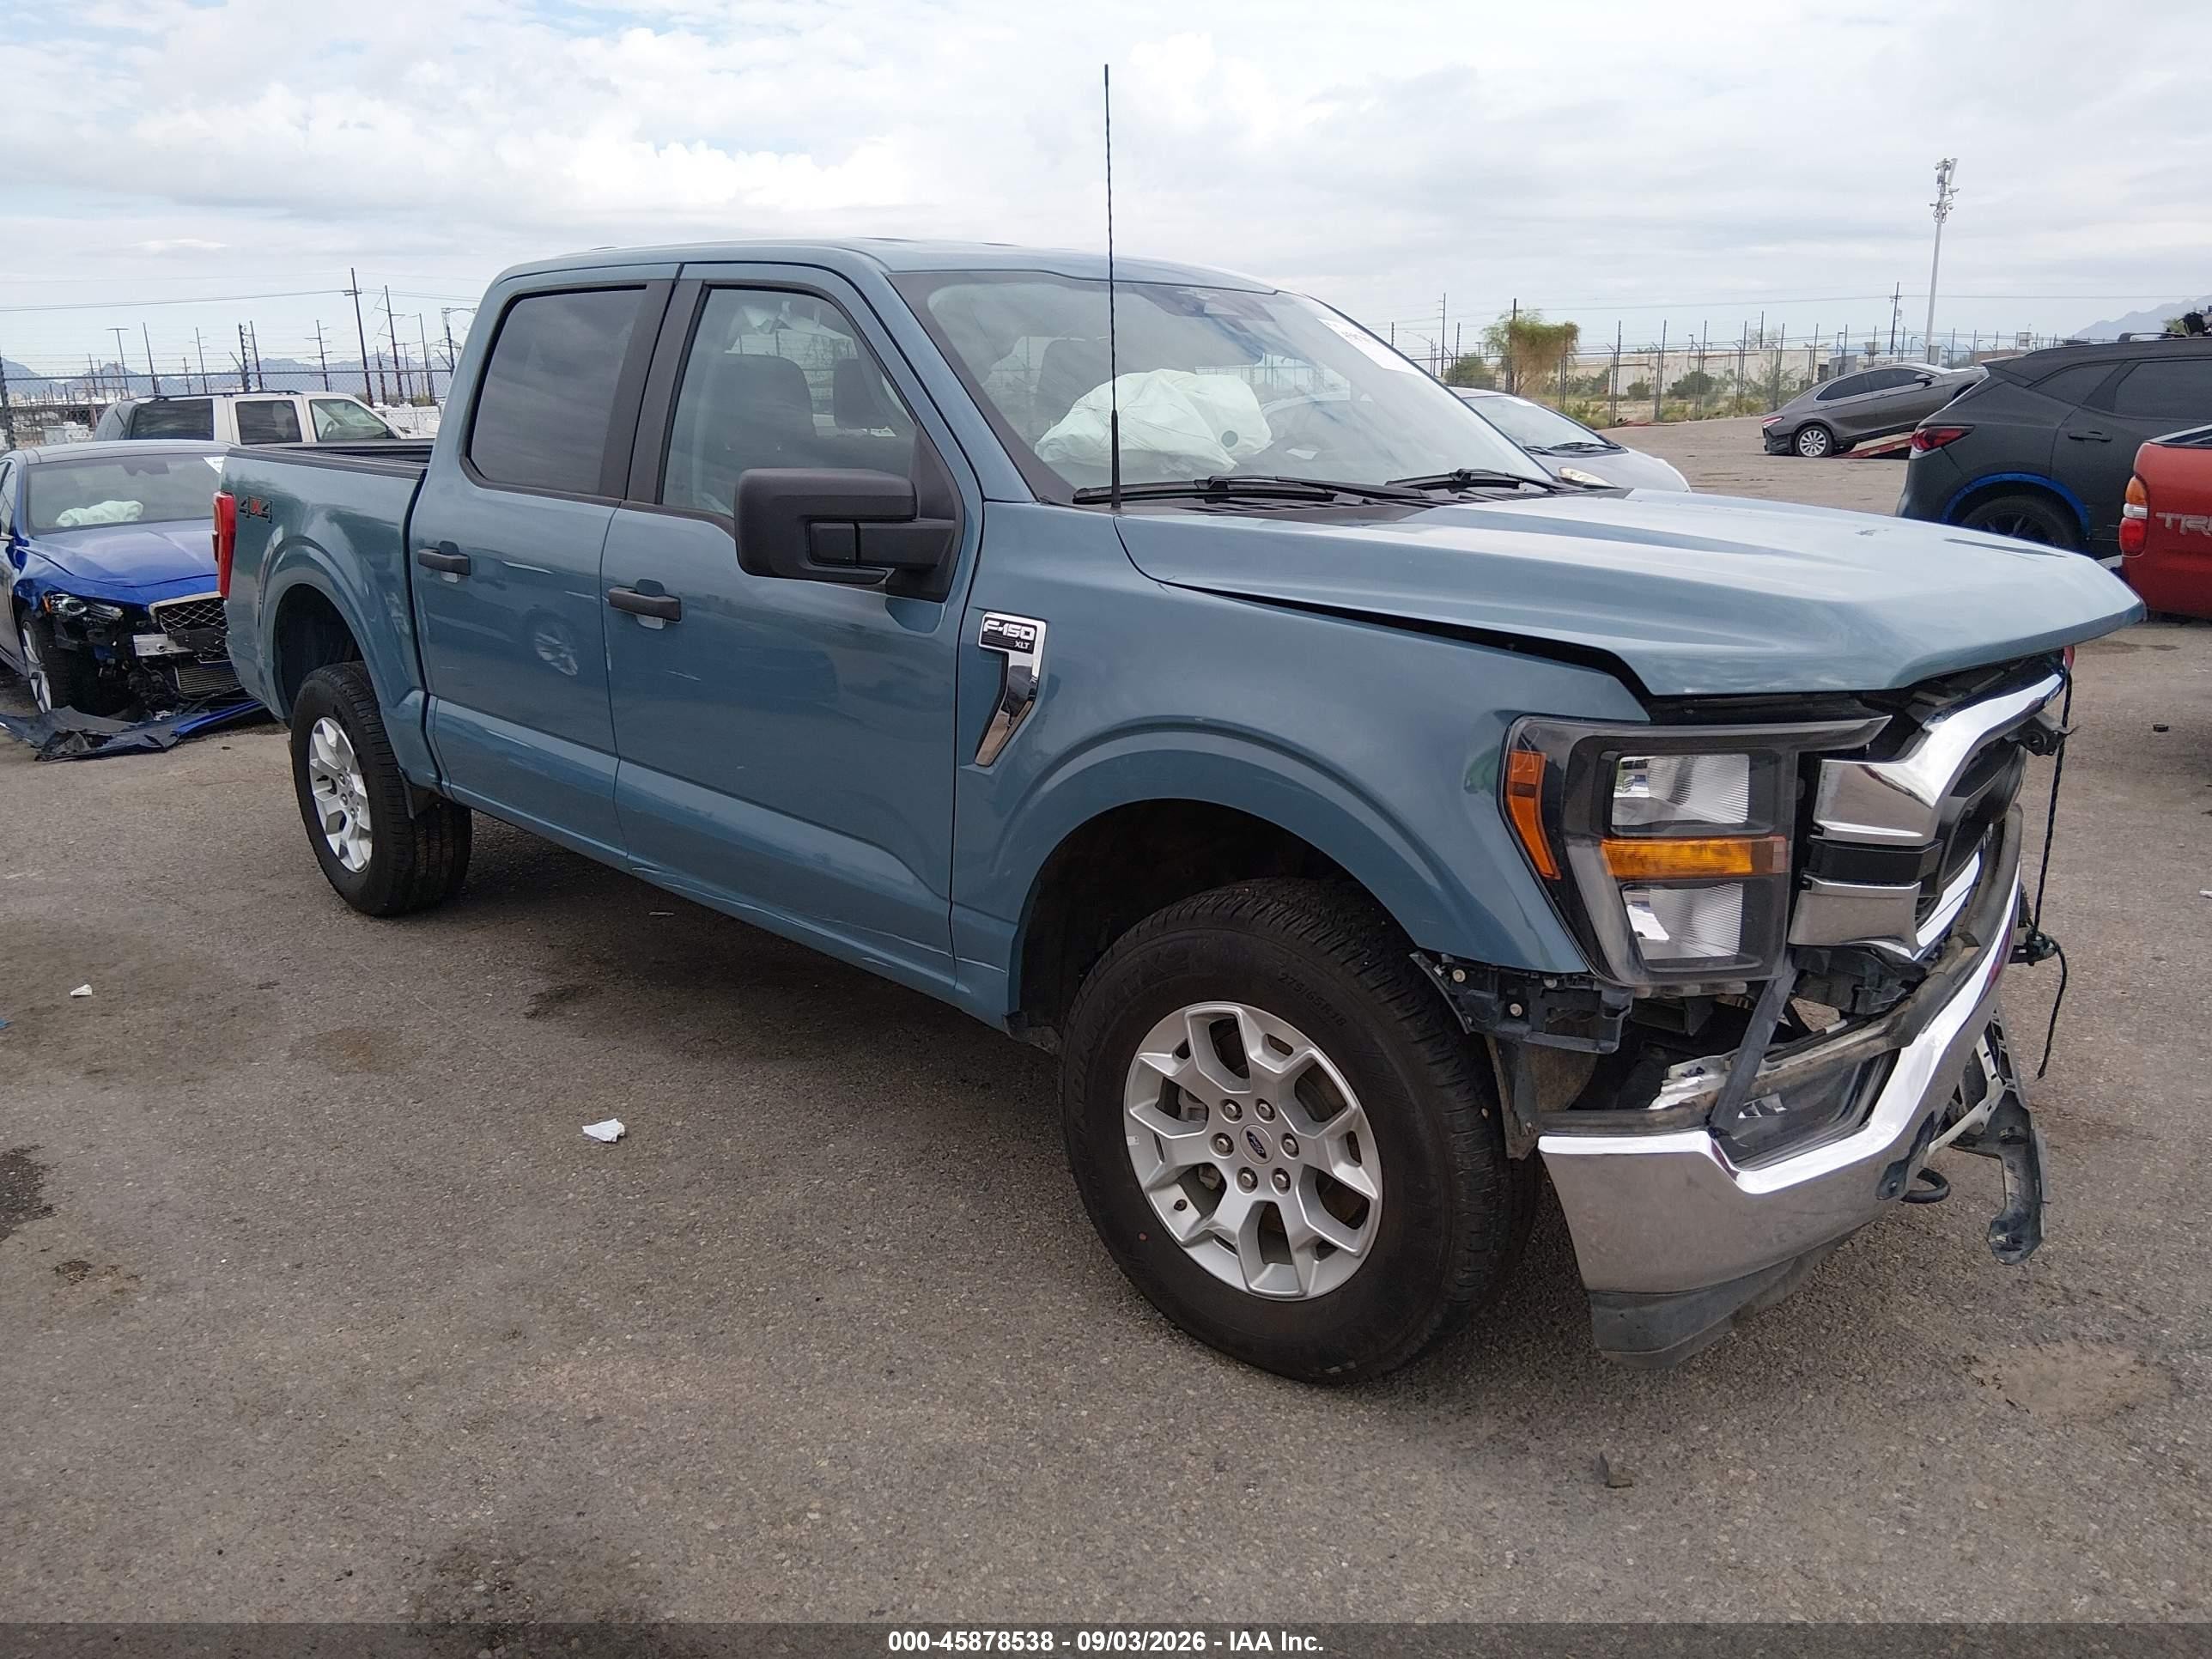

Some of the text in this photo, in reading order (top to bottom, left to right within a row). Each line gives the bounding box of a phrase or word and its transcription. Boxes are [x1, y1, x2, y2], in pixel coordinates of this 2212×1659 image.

[2155, 512, 2212, 538] TR
[983, 620, 1036, 641] F-150
[1014, 641, 1030, 649] XLT
[1277, 971, 1347, 1027] 275/65R18
